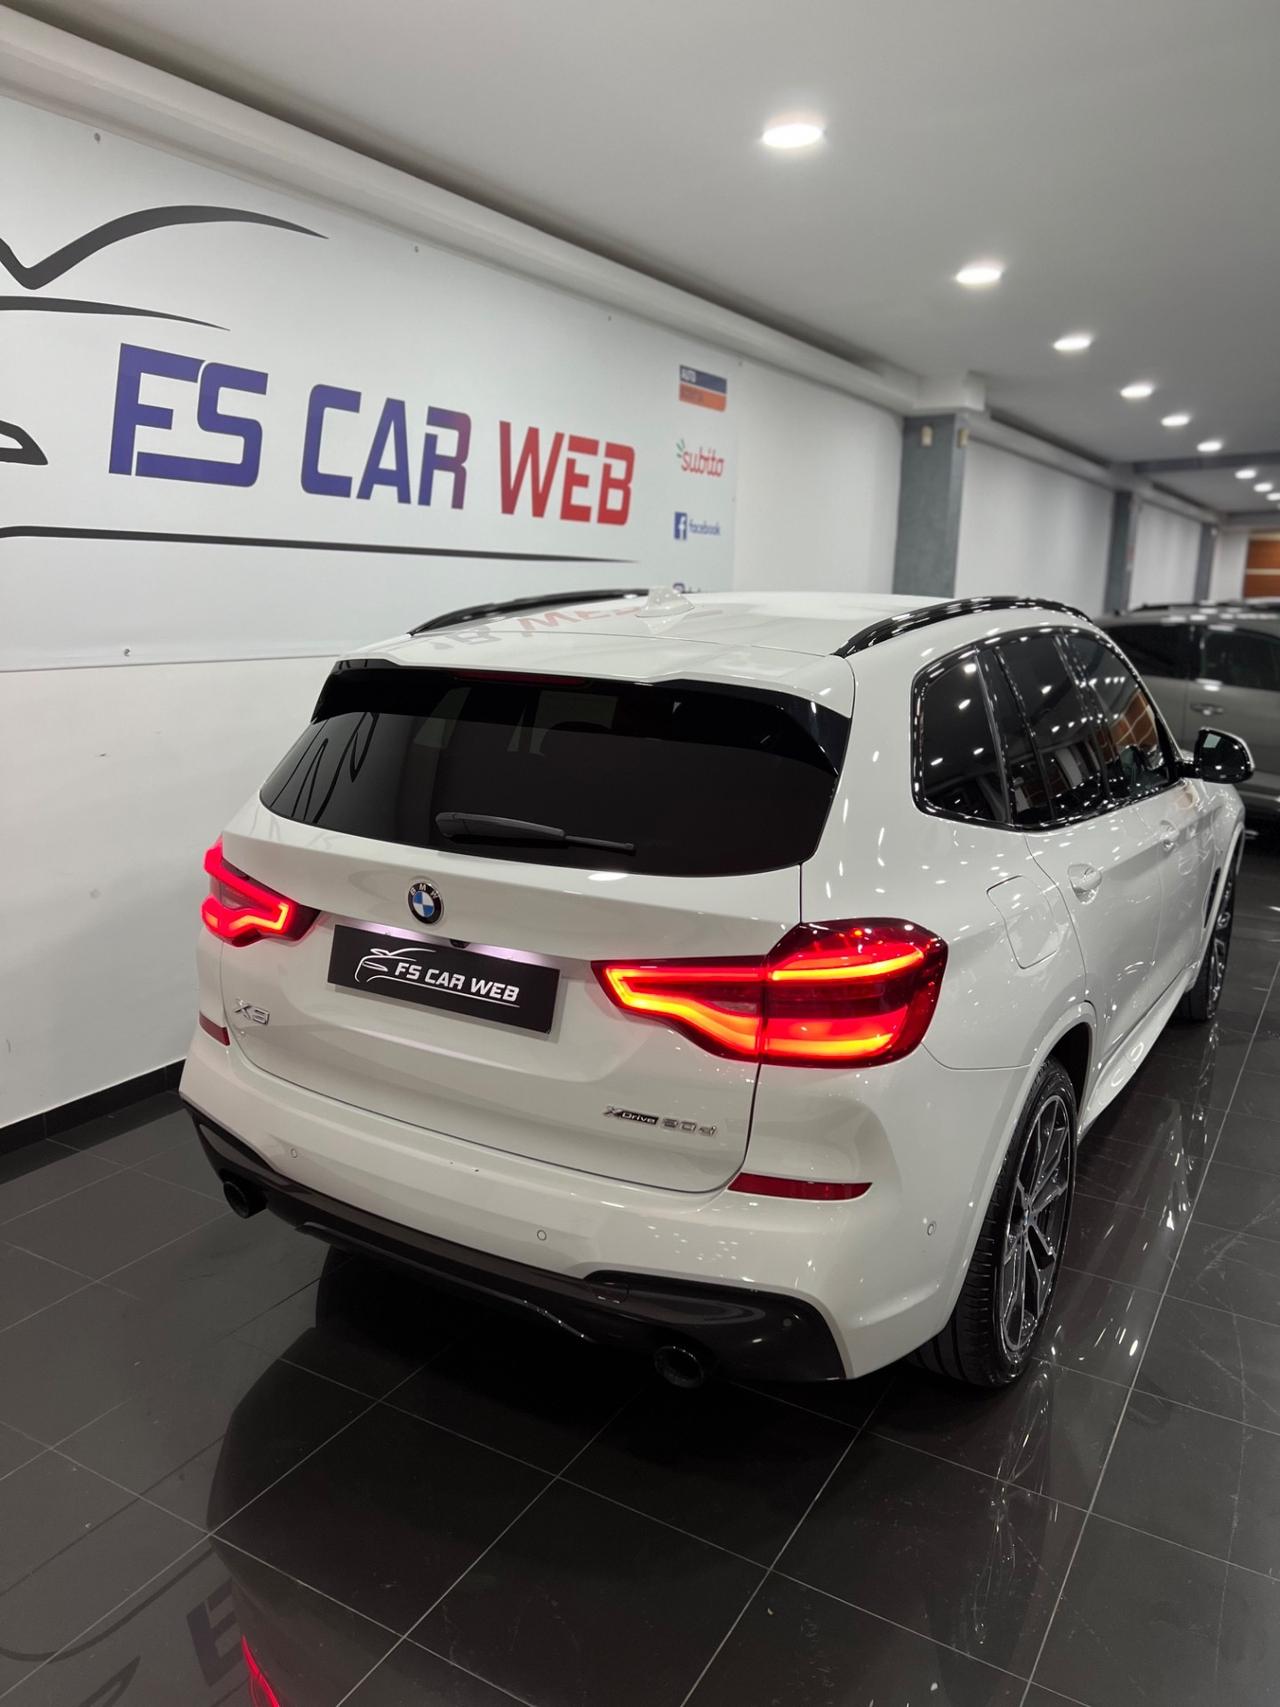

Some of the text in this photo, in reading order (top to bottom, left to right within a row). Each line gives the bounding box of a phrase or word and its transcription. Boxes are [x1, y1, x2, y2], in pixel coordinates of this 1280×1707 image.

[109, 343, 636, 526] FS CAR WEB
[681, 446, 724, 477] subito
[410, 883, 439, 899] BMW
[394, 962, 520, 1002] FS CAR WEB
[234, 998, 270, 1025] X3
